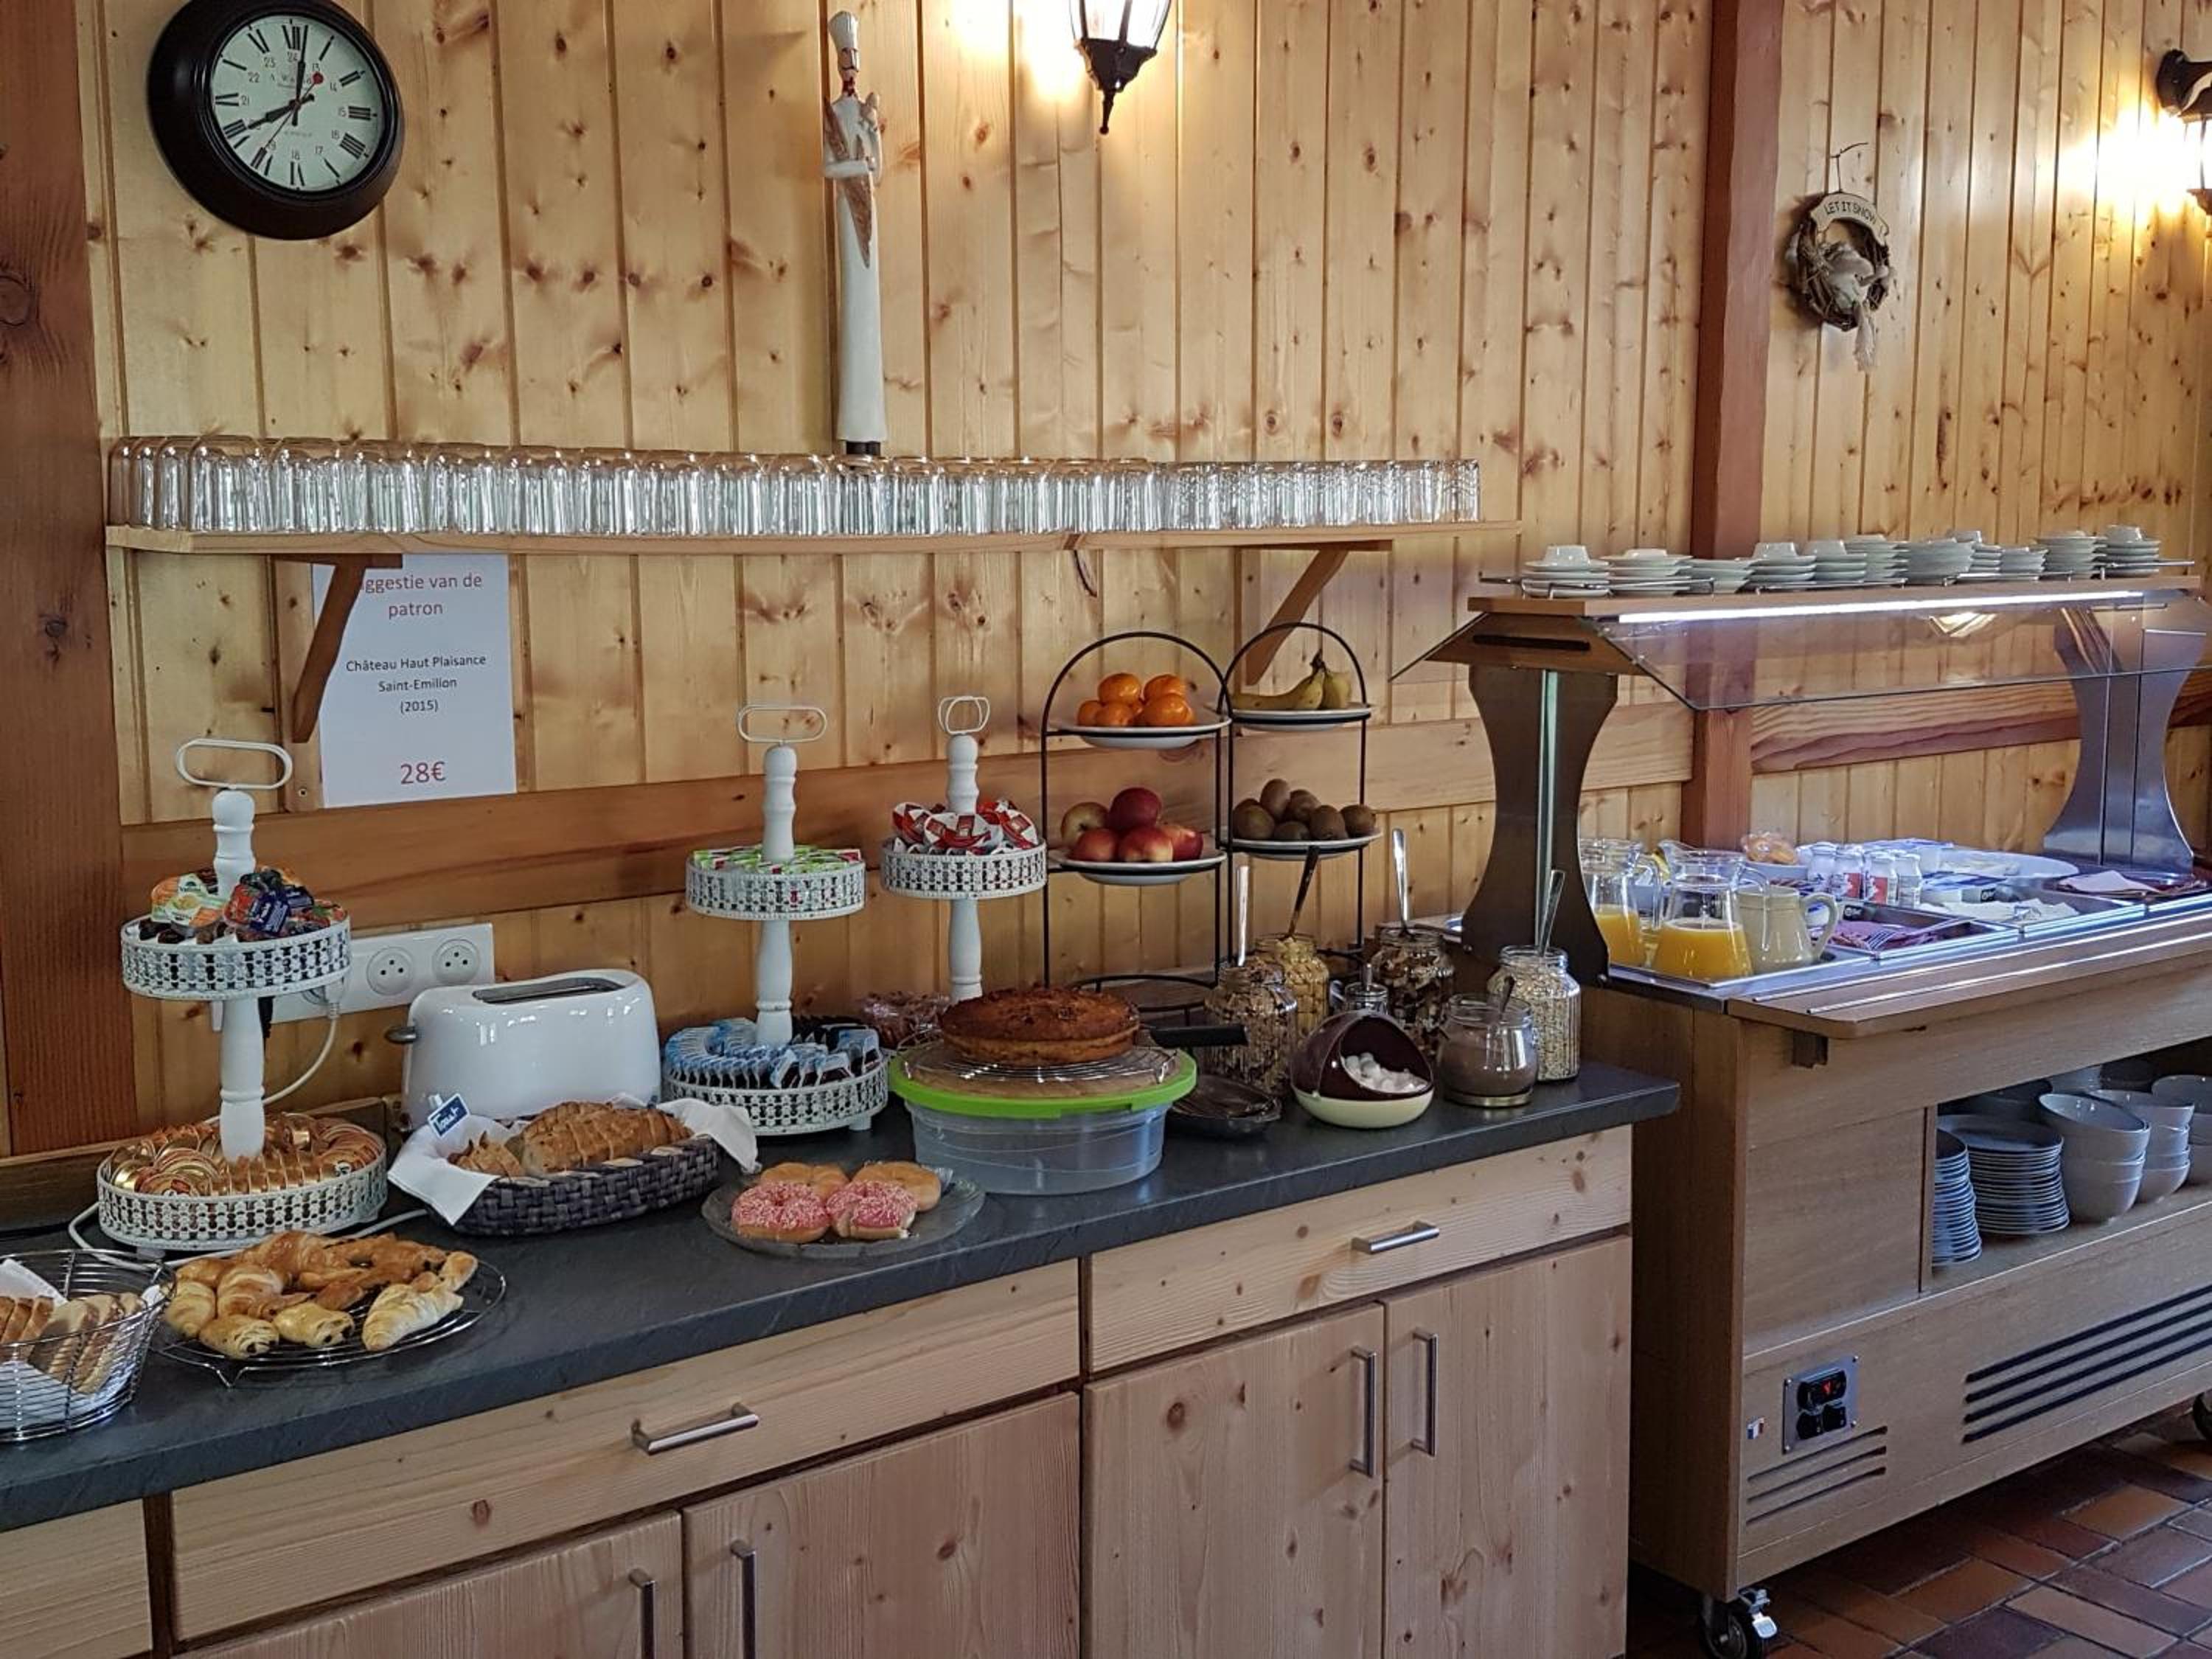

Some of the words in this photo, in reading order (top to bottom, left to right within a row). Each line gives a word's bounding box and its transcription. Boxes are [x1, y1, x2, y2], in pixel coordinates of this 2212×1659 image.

[248, 72, 260, 83] 22
[1823, 201, 1840, 215] LET
[1842, 201, 1851, 212] IT
[361, 574, 425, 594] ggestie
[429, 577, 458, 588] van
[462, 572, 482, 588] de
[389, 602, 444, 620] patron
[346, 659, 397, 672] Château
[400, 658, 429, 669] Haut
[433, 655, 487, 667] Plaisance
[400, 699, 439, 714] (2015)
[400, 760, 446, 785] 28€
